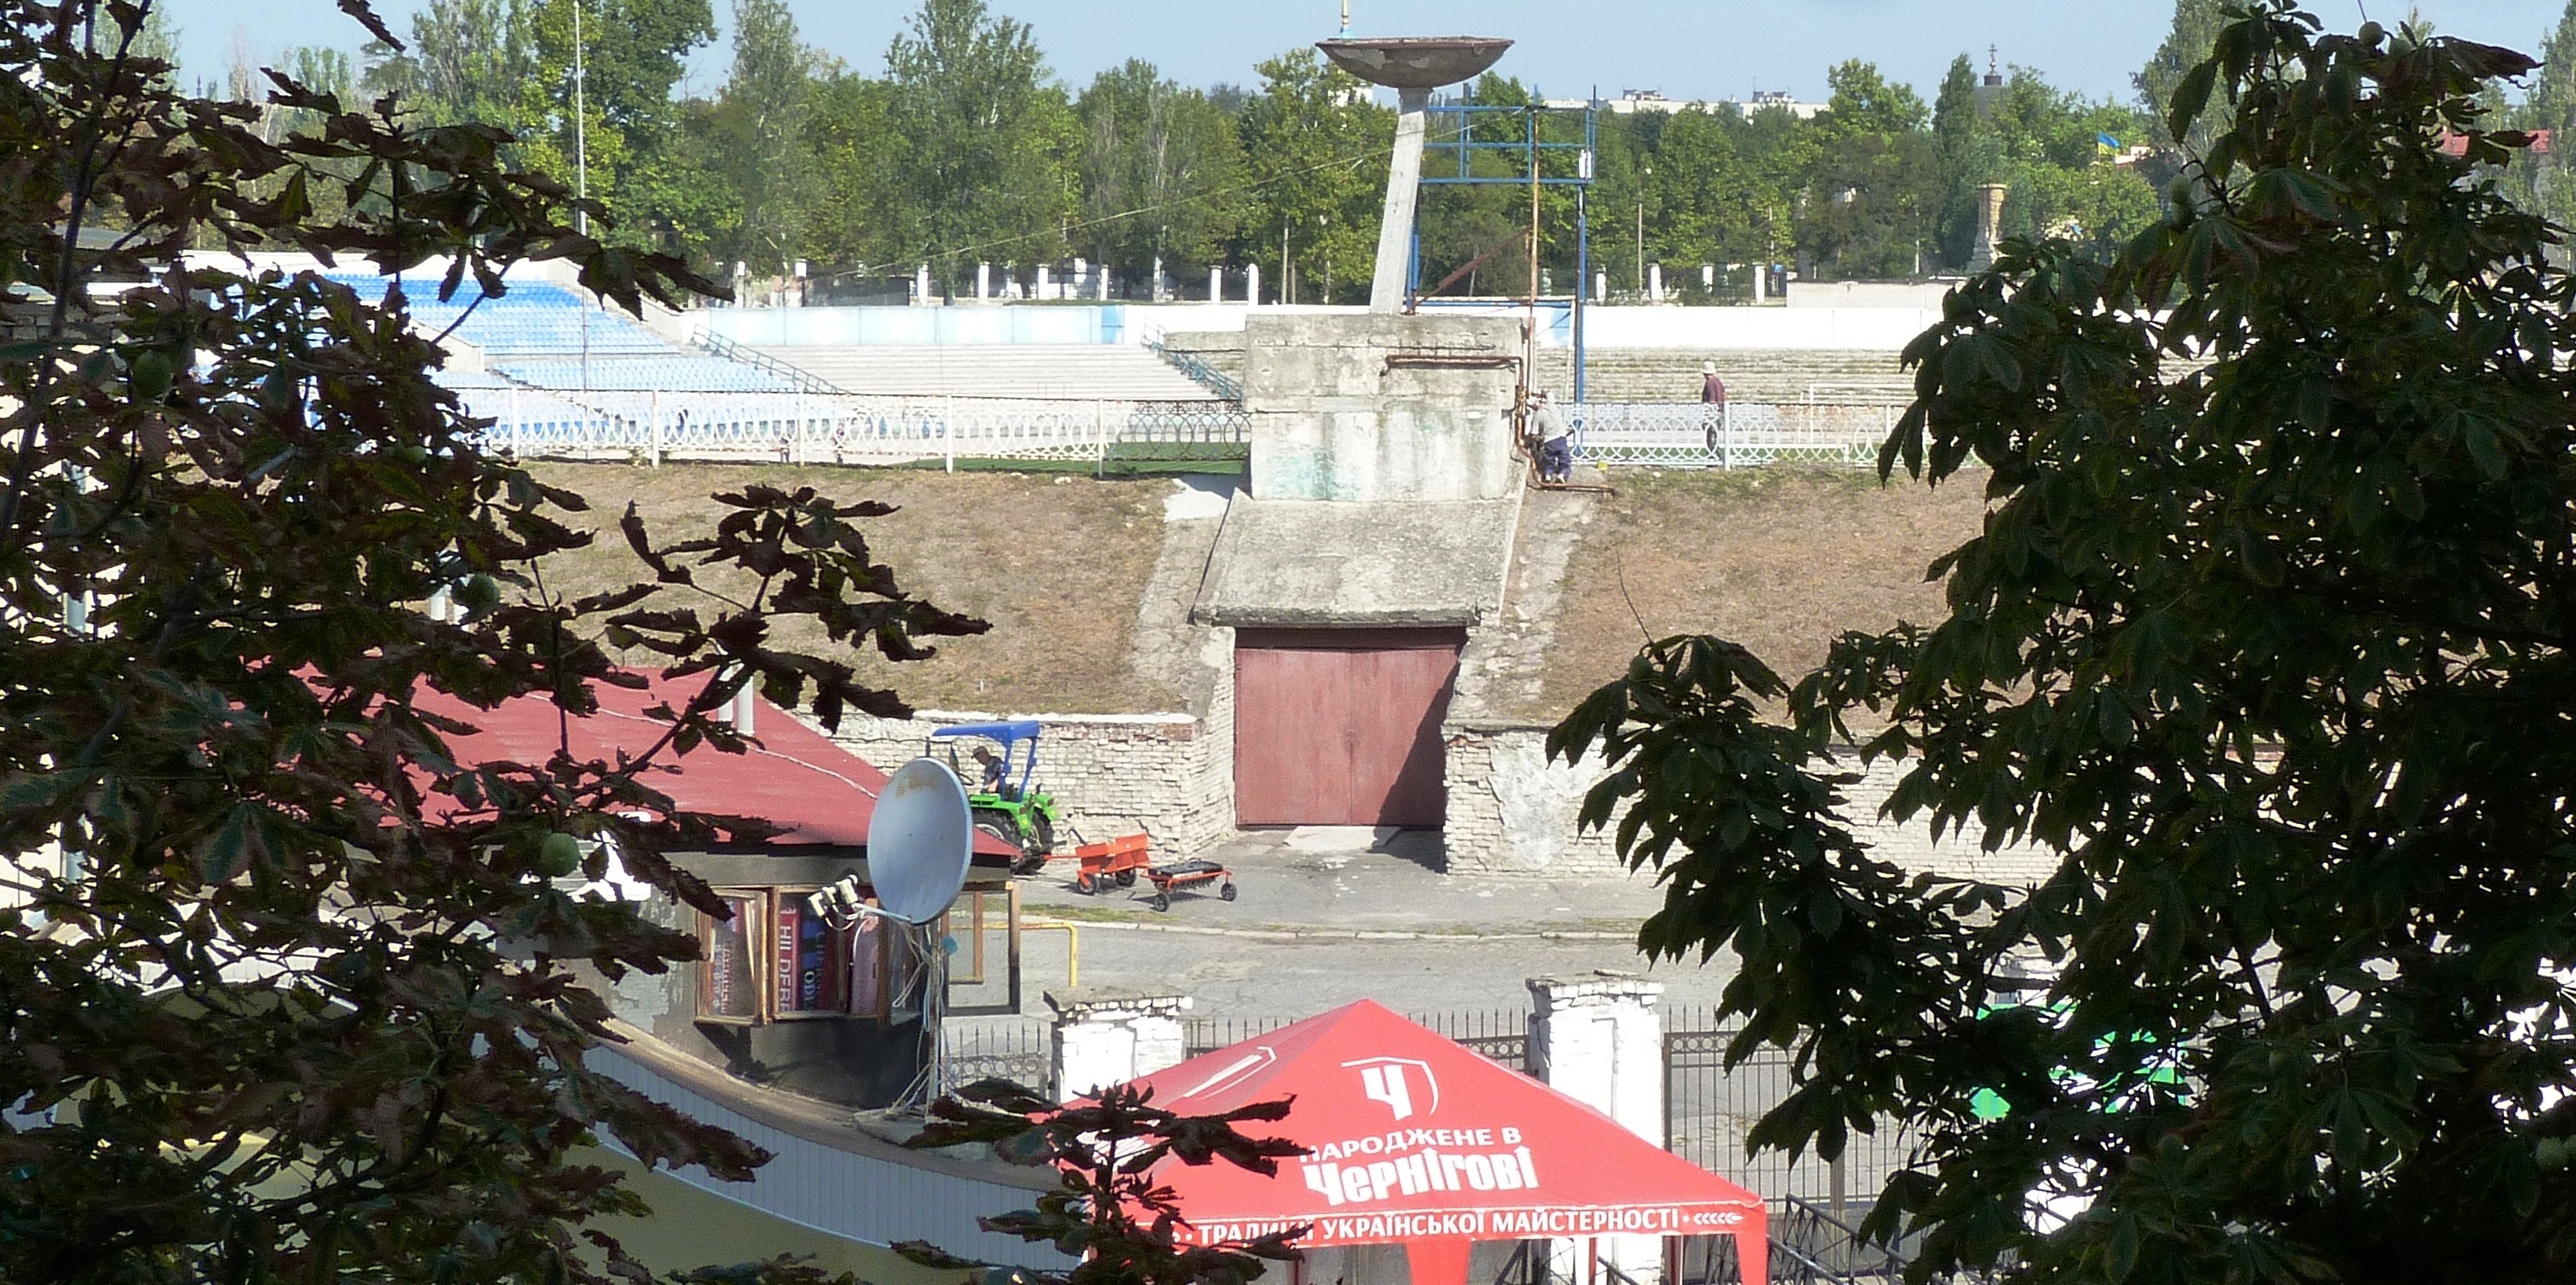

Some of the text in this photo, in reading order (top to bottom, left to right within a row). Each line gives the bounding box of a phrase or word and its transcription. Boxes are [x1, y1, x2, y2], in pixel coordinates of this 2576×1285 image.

[1501, 1127, 1522, 1145] В
[1322, 1211, 1485, 1239] УКРАЇНСЬКОЇ
[1493, 1207, 1678, 1233] МАЙСТЕРНОСТІ
